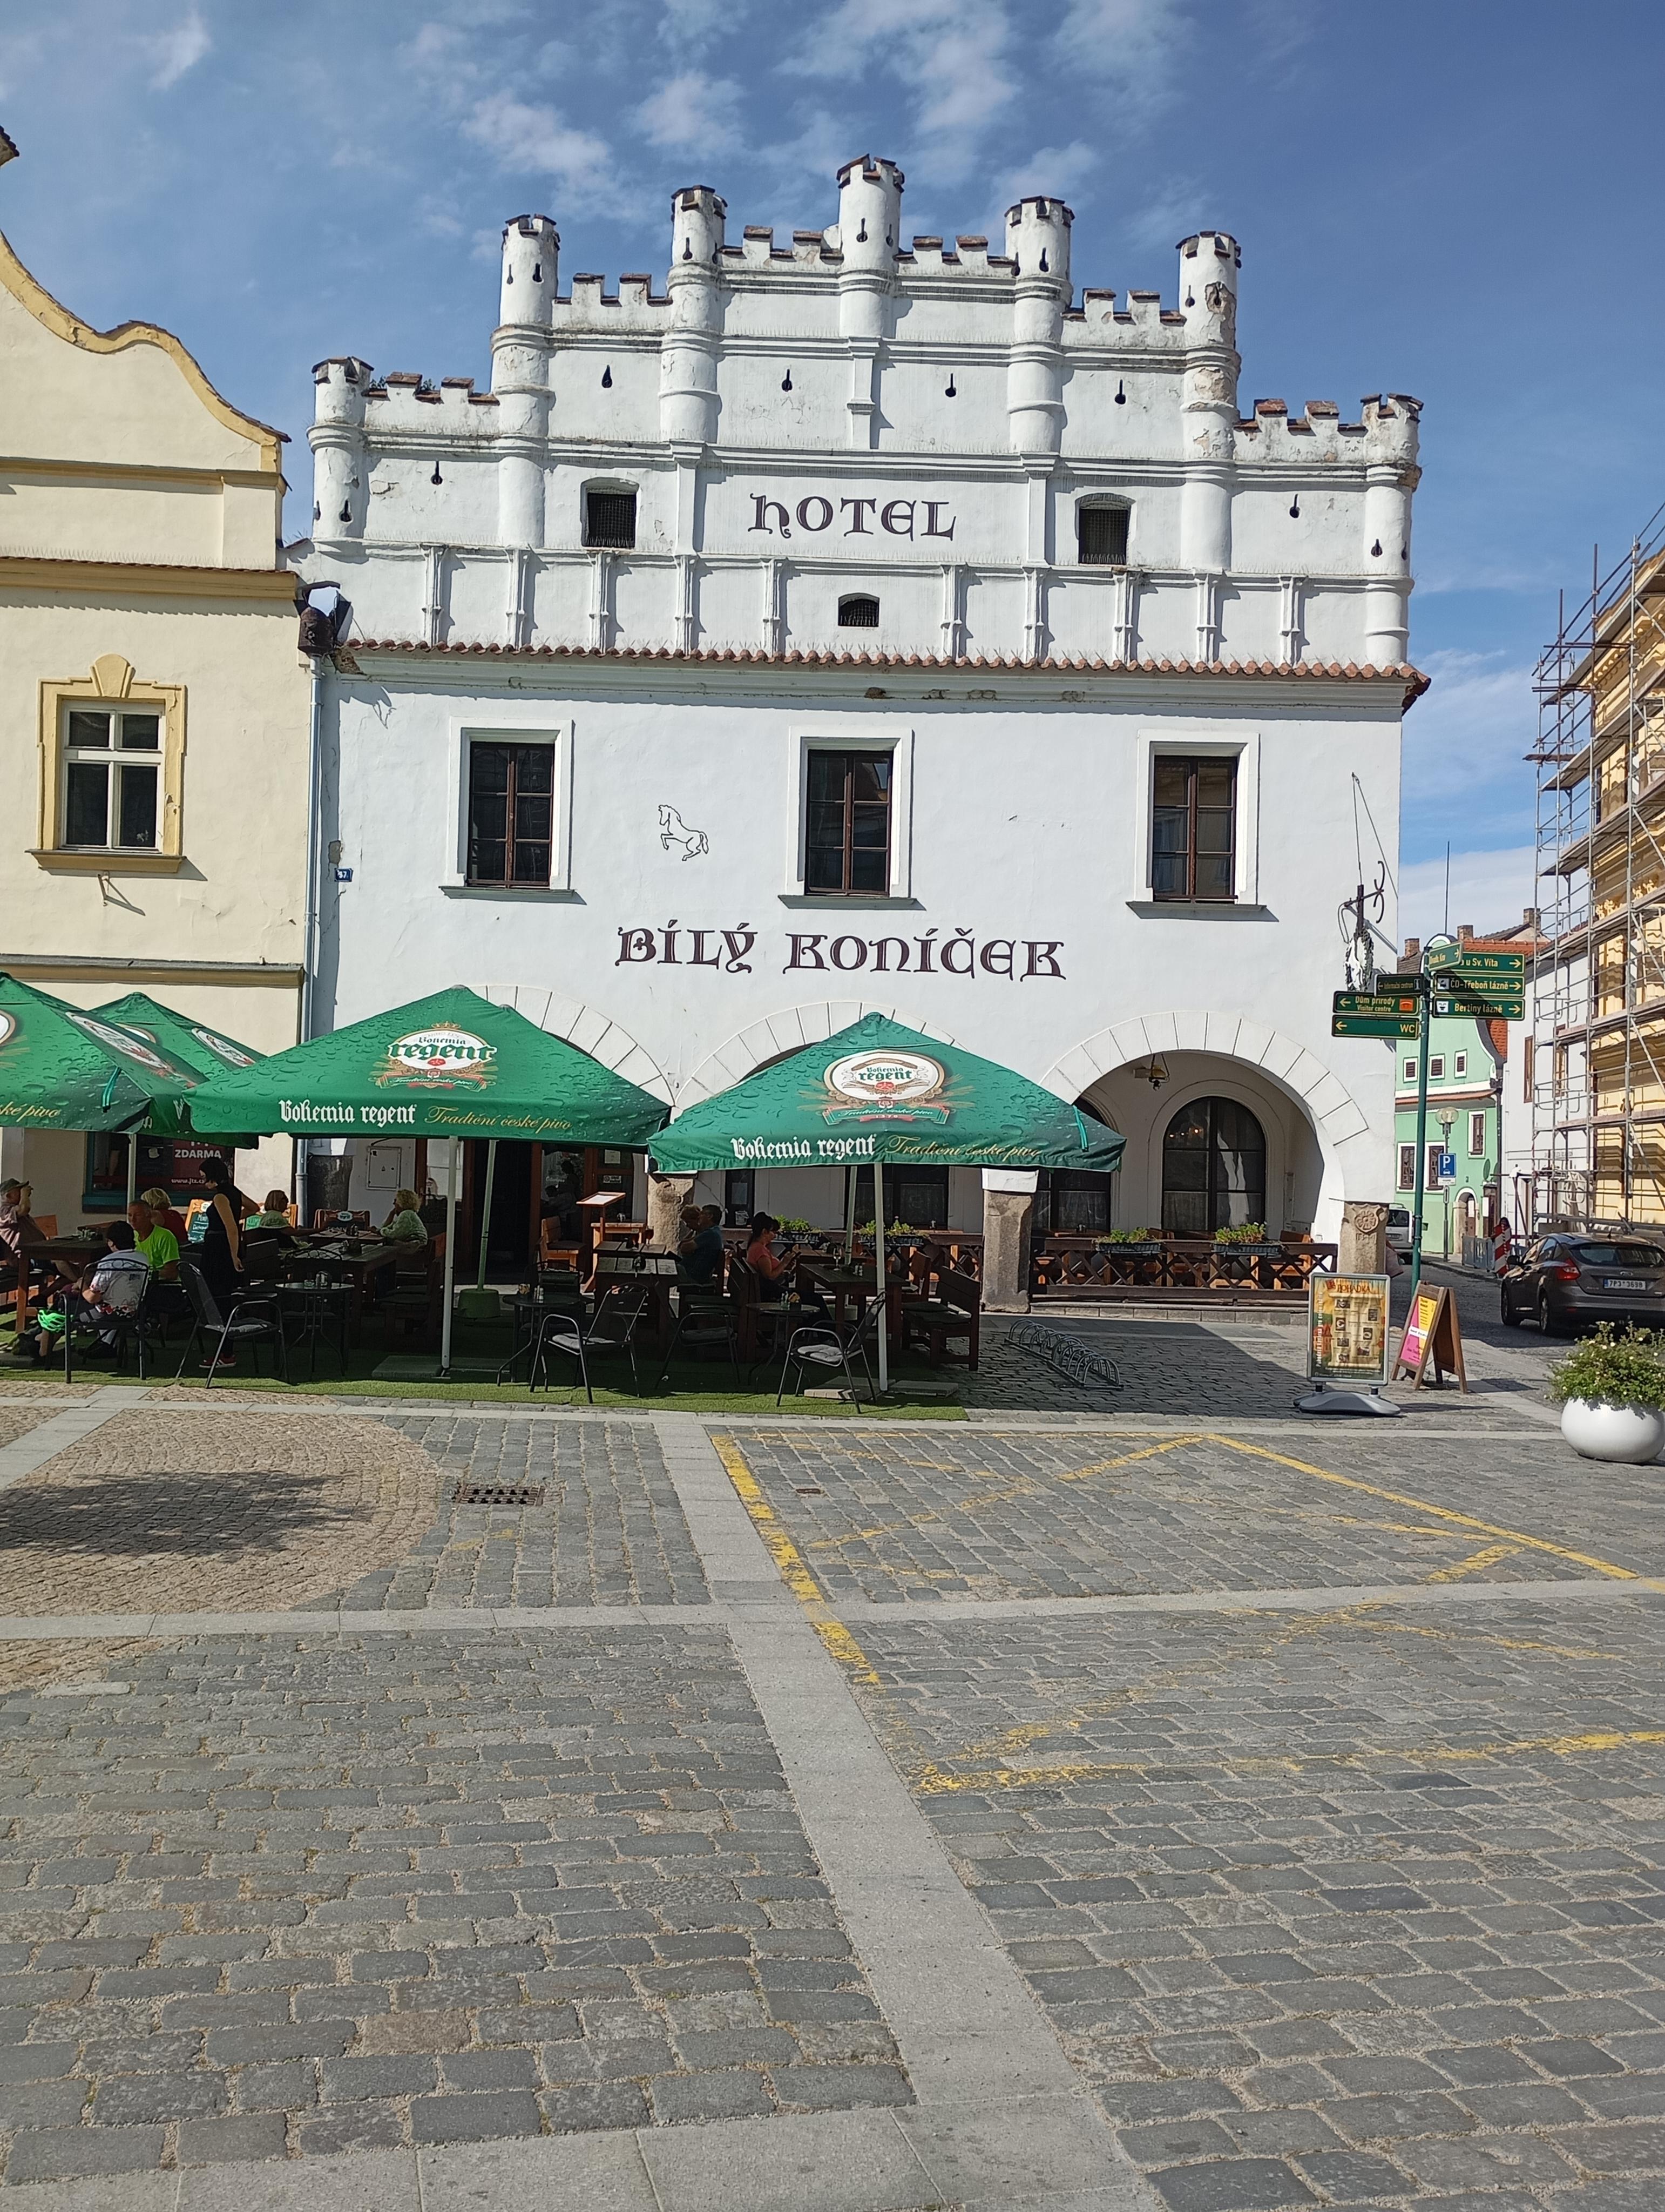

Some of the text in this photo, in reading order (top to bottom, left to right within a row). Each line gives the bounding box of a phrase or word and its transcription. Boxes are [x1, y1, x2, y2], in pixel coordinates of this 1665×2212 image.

[747, 493, 956, 542] HOTEL
[614, 919, 1066, 982] BÍLÝ KONÍČEK
[1472, 958, 1483, 967] Sv.
[1484, 958, 1499, 967] Víta
[1450, 977, 1509, 990] ČD-Třeboň lázně
[1355, 995, 1370, 1004] Dům
[1454, 1003, 1503, 1014] Bertiny lázně
[1400, 1024, 1415, 1033] WC
[418, 1036, 466, 1046] Bohemia
[387, 1042, 498, 1062] regent
[858, 1070, 912, 1082] regent
[16, 1103, 61, 1122] pivo
[278, 1100, 573, 1134] Bohemia regent Tradiční české pivo
[174, 1149, 222, 1159] ZDARMA
[730, 1134, 1043, 1161] Bohemia regent Tradiční české pivo
[1443, 1156, 1451, 1169] P
